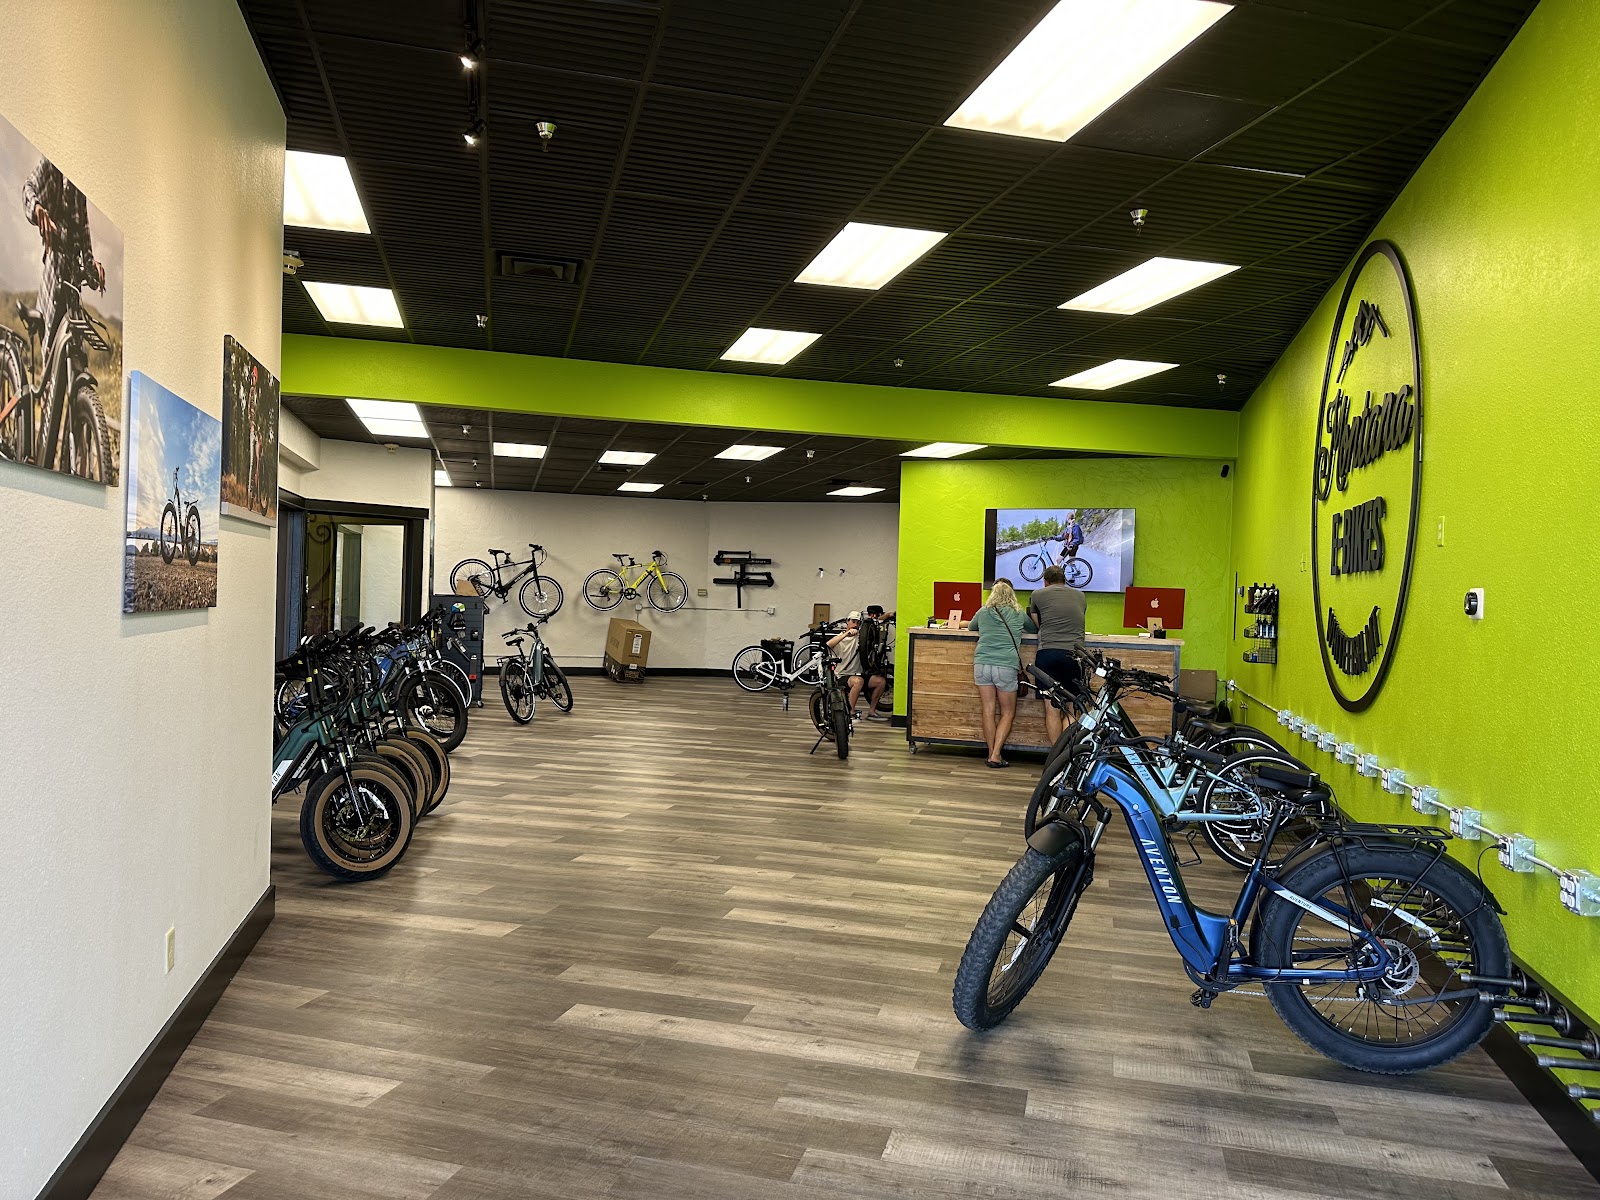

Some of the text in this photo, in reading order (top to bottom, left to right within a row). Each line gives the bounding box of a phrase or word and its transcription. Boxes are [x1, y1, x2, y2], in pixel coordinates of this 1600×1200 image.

[1316, 385, 1414, 501] Montana
[1330, 496, 1387, 576] E-BIKES
[1140, 837, 1183, 904] AVENTON
